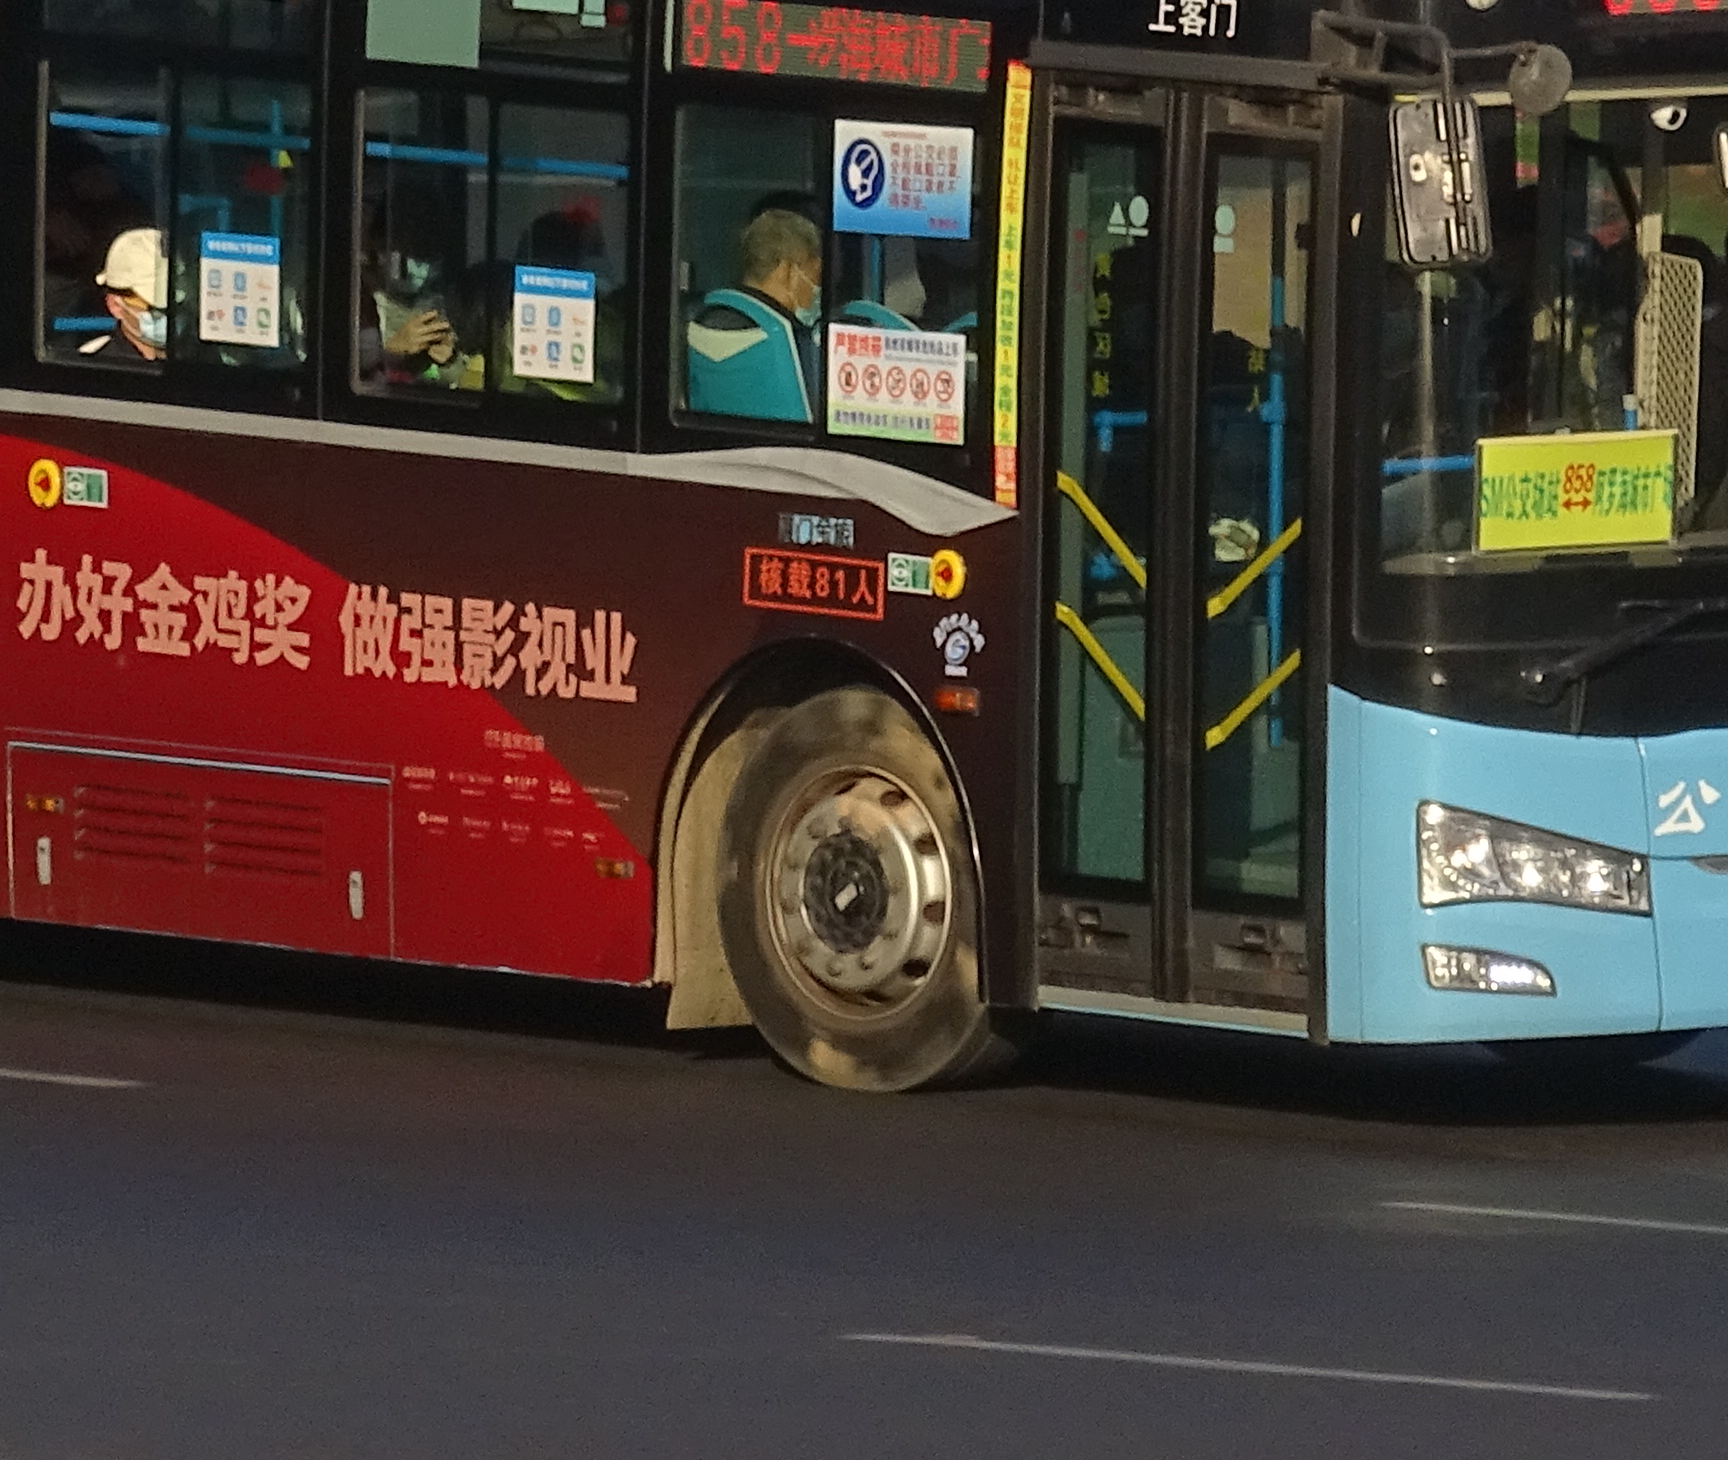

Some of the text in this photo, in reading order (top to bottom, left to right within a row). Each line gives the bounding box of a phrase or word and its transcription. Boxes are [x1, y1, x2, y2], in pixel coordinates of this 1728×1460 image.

[1562, 462, 1596, 495] 858
[758, 555, 875, 607] 核载81人
[15, 547, 638, 704] 办好金鸡奖 做强影视业
